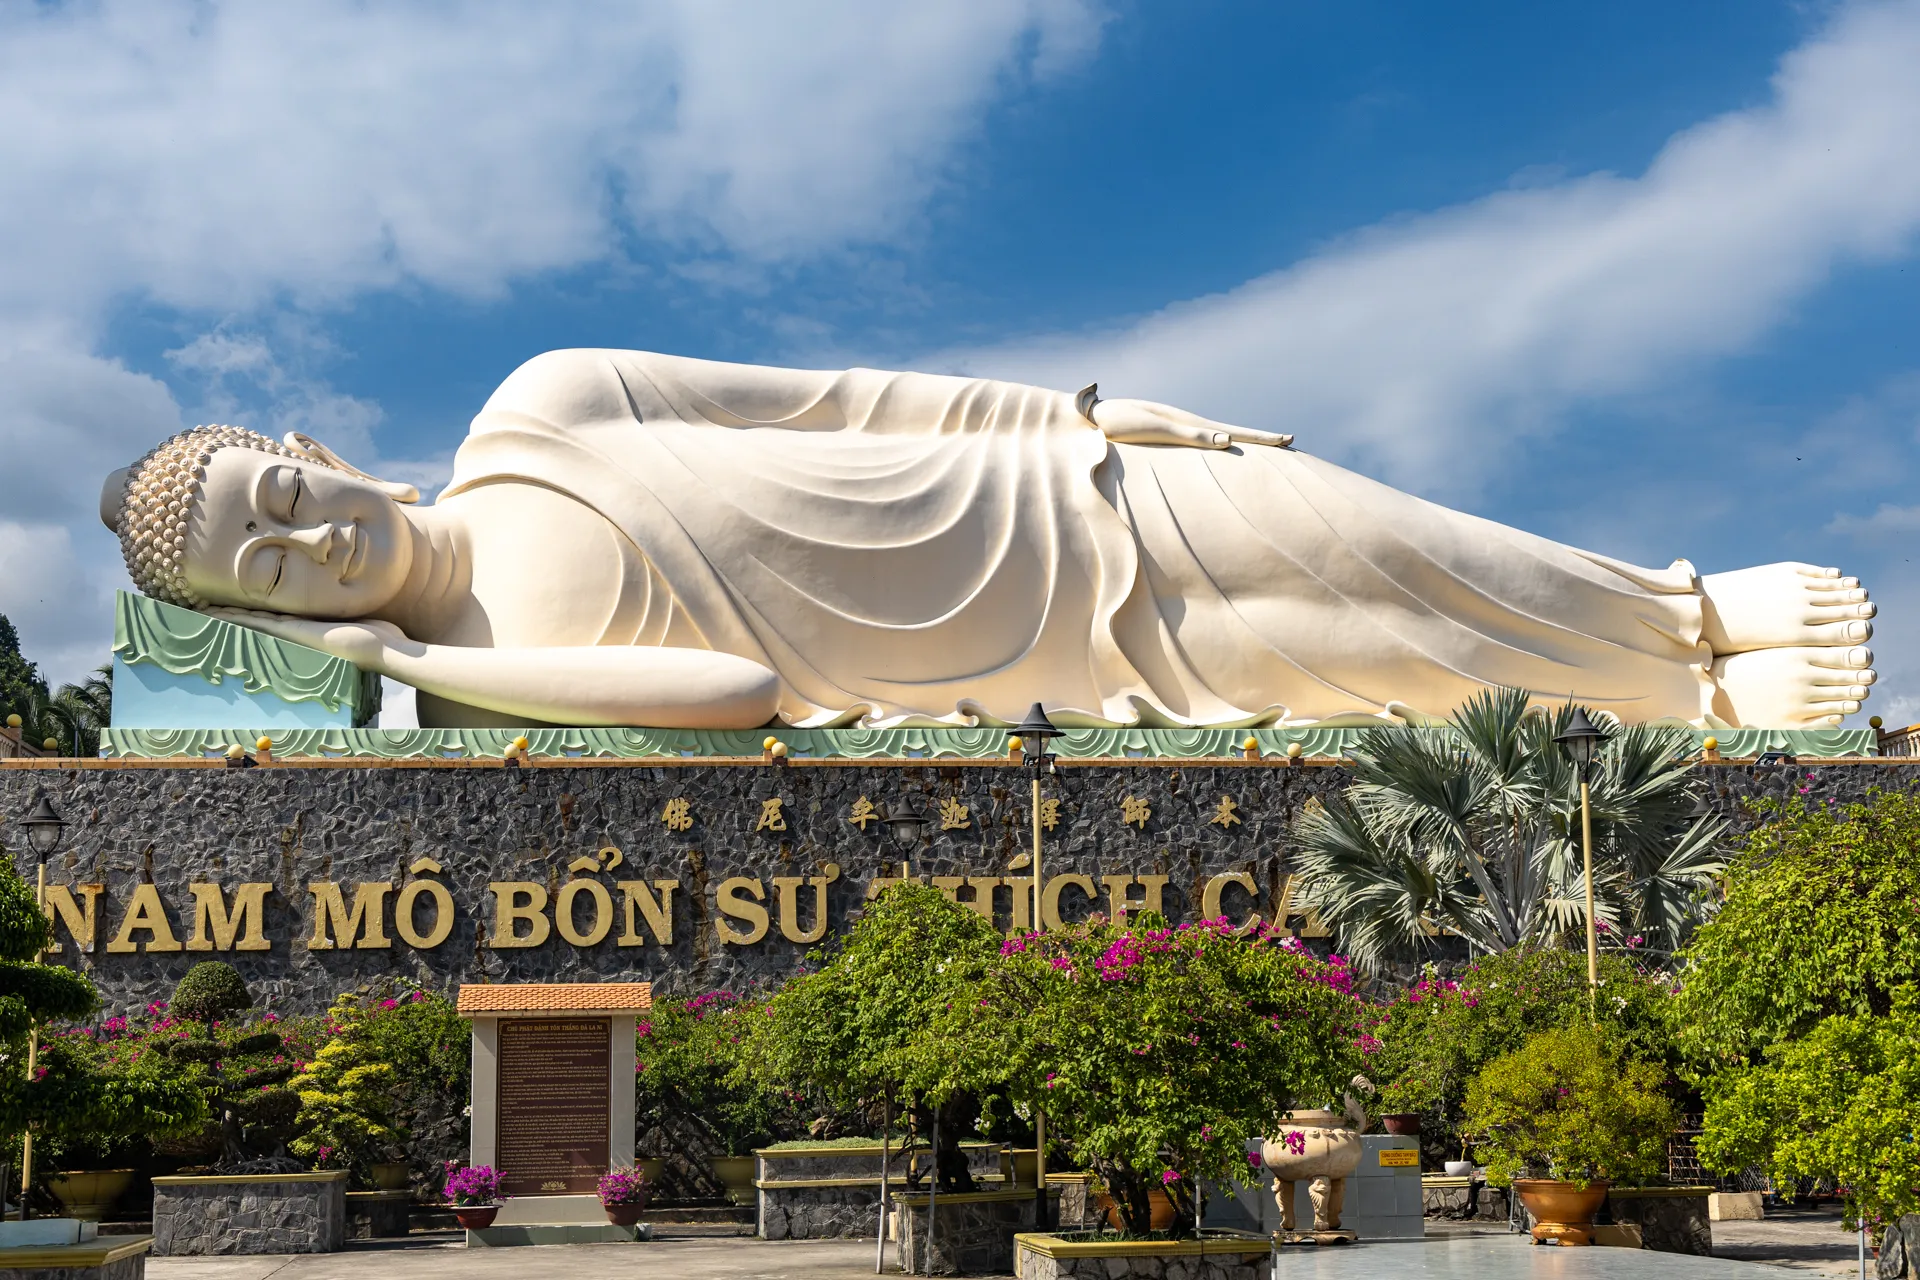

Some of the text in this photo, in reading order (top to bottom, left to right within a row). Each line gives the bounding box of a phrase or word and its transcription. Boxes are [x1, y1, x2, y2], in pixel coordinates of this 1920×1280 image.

[44, 882, 273, 954] NAM
[307, 857, 455, 950] MÔ
[488, 846, 680, 948] BỔN
[714, 862, 841, 946] SƯ
